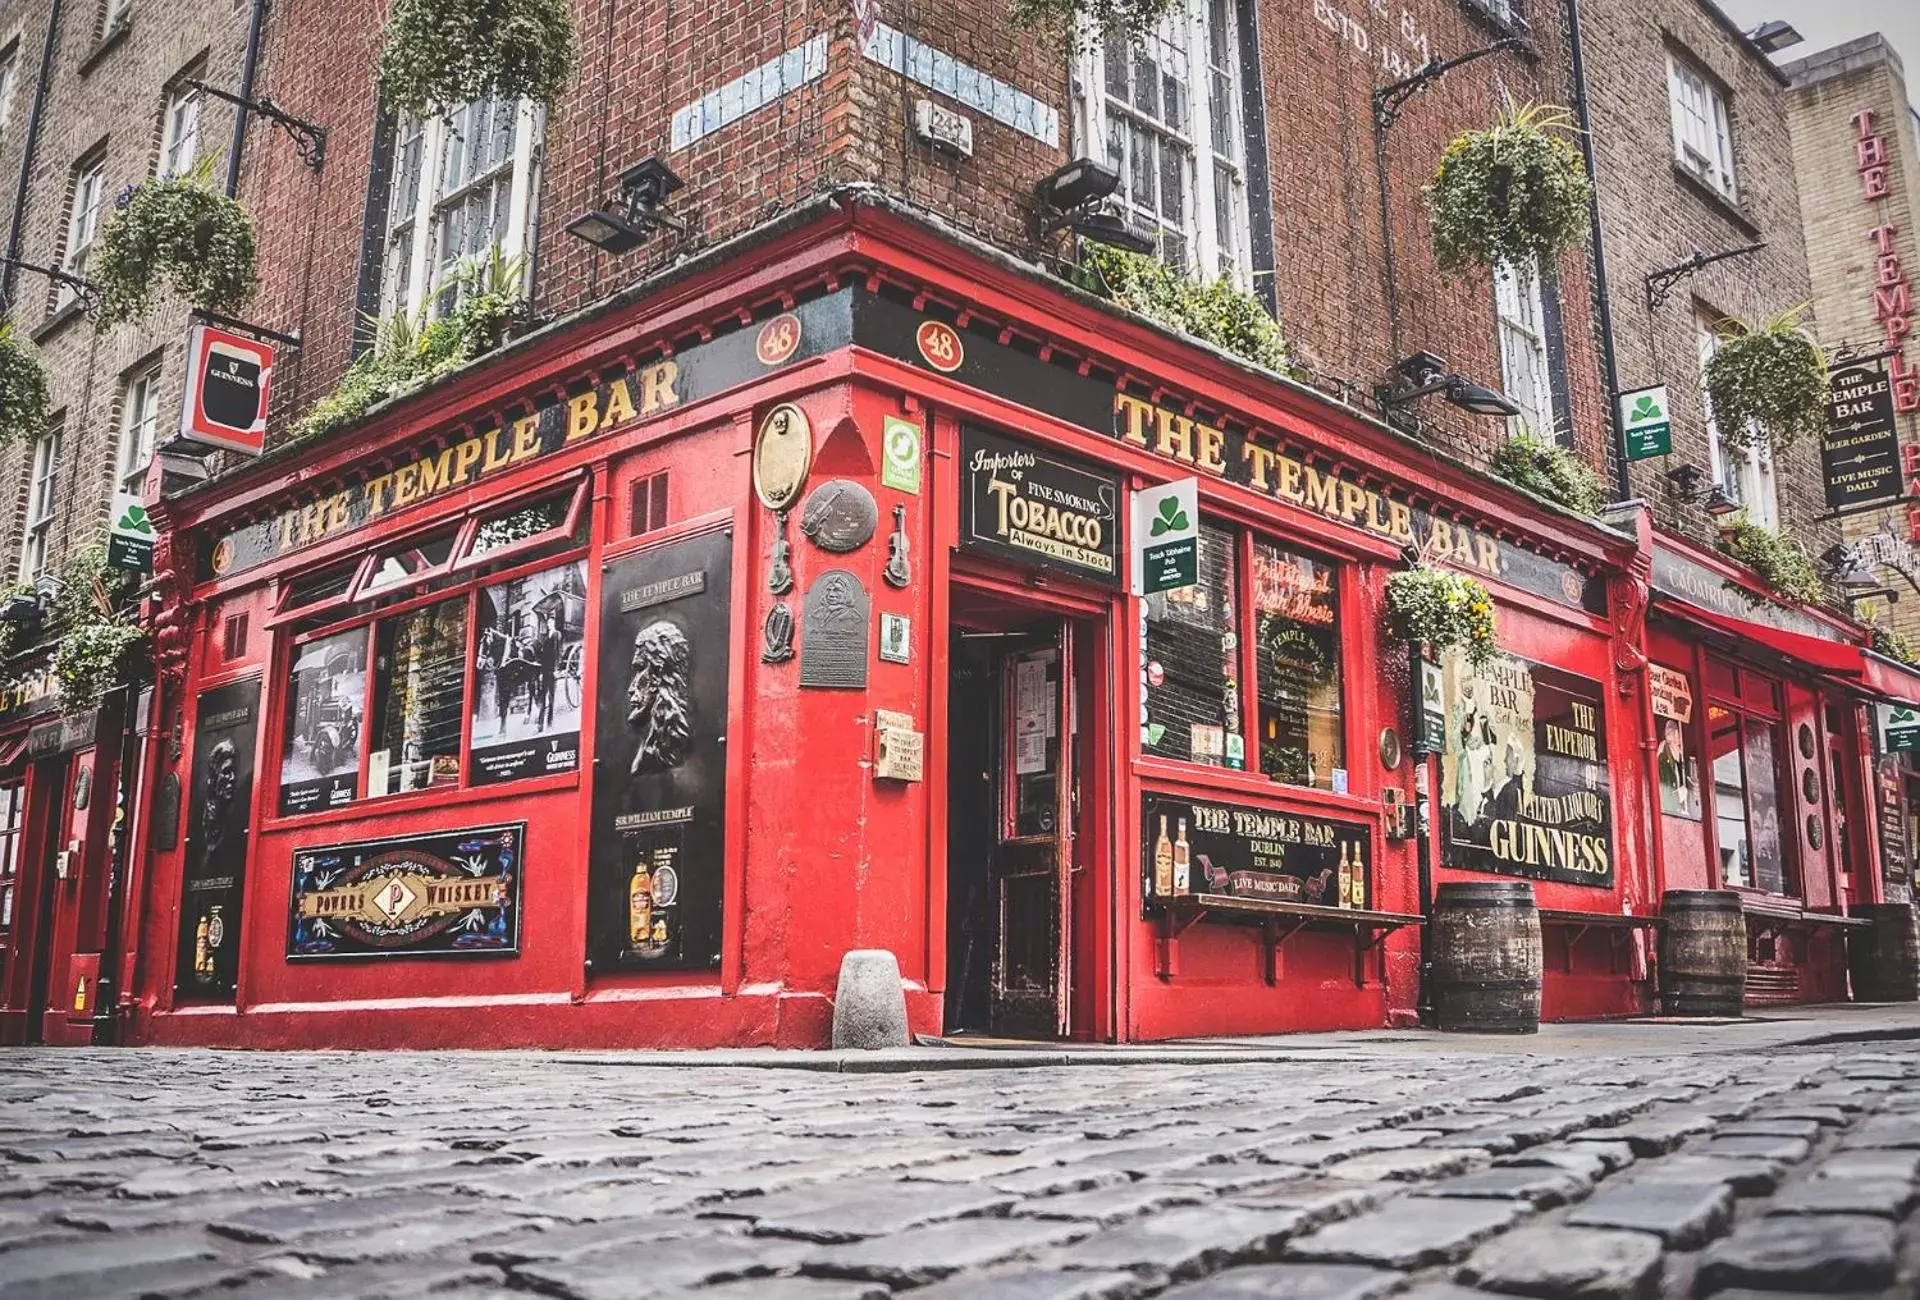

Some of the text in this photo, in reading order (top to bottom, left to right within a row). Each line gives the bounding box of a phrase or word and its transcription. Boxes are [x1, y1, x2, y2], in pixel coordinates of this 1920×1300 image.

[1852, 109, 1892, 200] THE
[1866, 223, 1918, 412] TEMPLE
[764, 326, 793, 356] 48
[924, 326, 954, 360] 48
[210, 368, 255, 388] GUINNESS
[1839, 374, 1863, 386] THE
[1836, 401, 1874, 418] BAR
[1851, 430, 1892, 445] GARDEN
[278, 360, 681, 550] THE TEMPLE BAR
[970, 449, 1035, 479] Importers
[1011, 469, 1023, 481] OF
[1117, 393, 1501, 573] THE TEMPLE BAR
[1831, 466, 1893, 485] LIVE MUSIC
[1847, 480, 1880, 492] DAILY
[1028, 482, 1101, 515] FINE SMOKING
[988, 479, 1102, 549] TOBACCO
[1012, 530, 1111, 568] Always in Stock
[622, 571, 702, 603] THE TEMPLE BAR
[1292, 593, 1334, 623] Music
[1271, 630, 1307, 648] TEMPLE
[1490, 686, 1519, 713] BAR
[1571, 702, 1596, 731] THE
[546, 750, 576, 763] GUINNESS
[1546, 723, 1597, 761] EMPEROR
[1585, 765, 1598, 790] OF
[628, 811, 660, 824] WILLIAM
[661, 806, 693, 819] TEMPLE
[1517, 788, 1604, 825] MALTED LIQUORS
[1193, 806, 1336, 848] THE TEMPLE BAR
[1251, 840, 1285, 856] DUBLIN
[1489, 819, 1608, 875] GUINNESS
[316, 894, 364, 914] POWERS
[426, 883, 492, 905] WHISKEY
[1234, 878, 1300, 894] LIVE MUSIC DAILY
